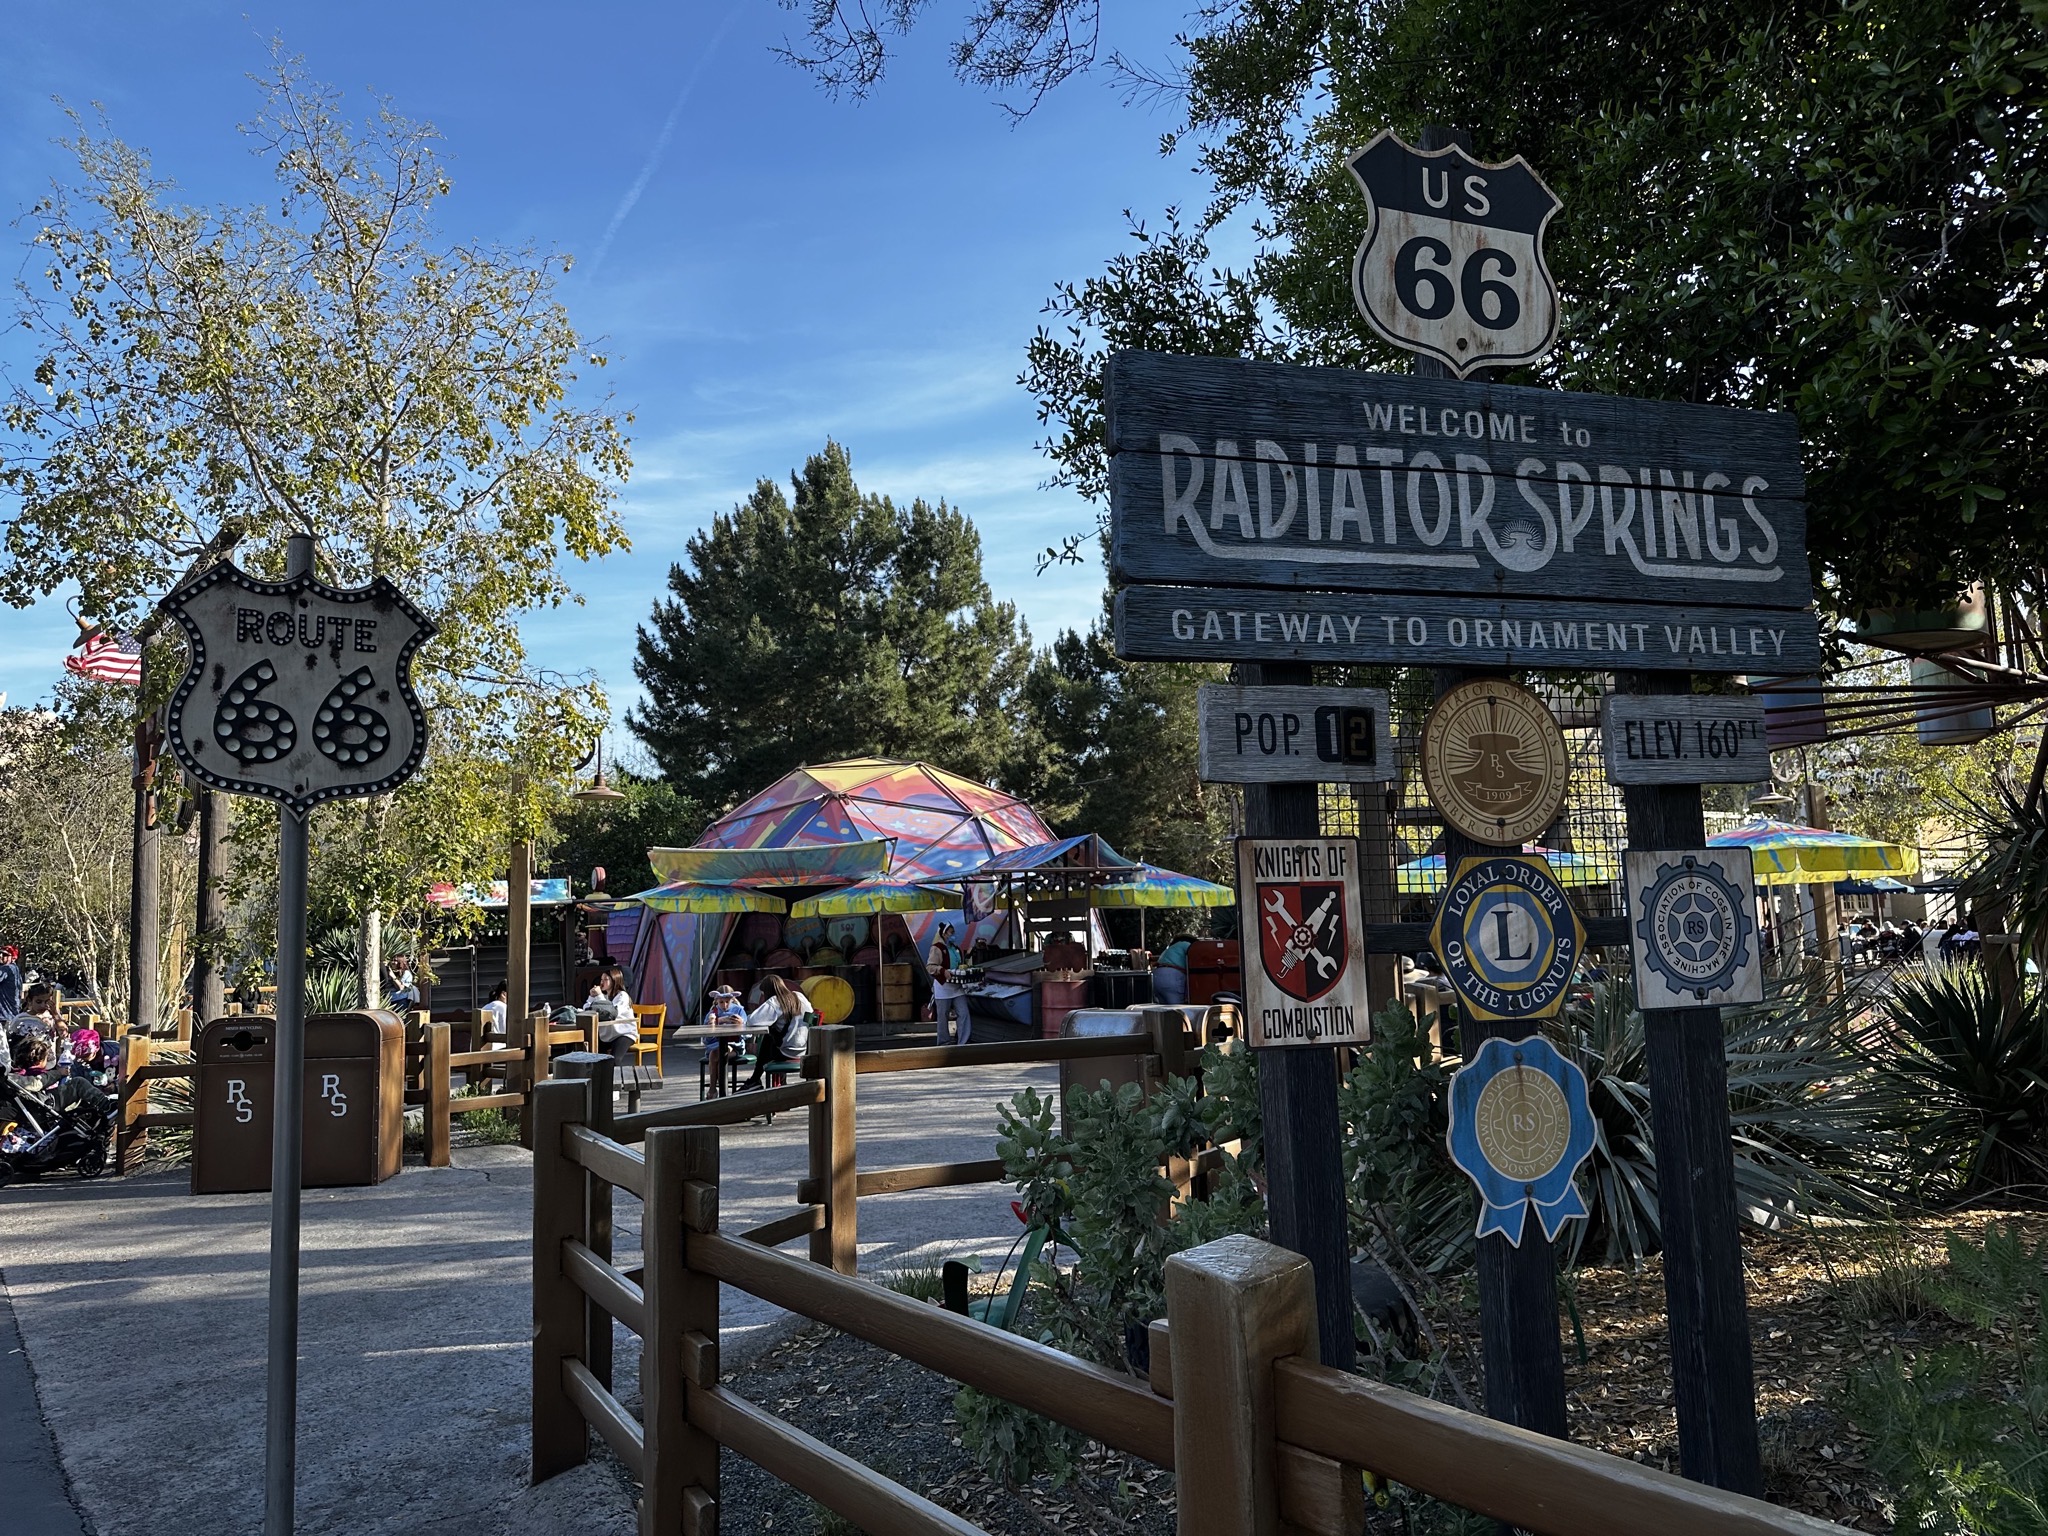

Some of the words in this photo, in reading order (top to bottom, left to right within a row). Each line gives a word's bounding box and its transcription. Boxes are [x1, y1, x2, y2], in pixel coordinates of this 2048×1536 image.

[1421, 167, 1491, 217] US
[1395, 236, 1521, 330] 66
[1363, 402, 1536, 444] WELCOME
[1560, 421, 1591, 448] to
[1159, 433, 1505, 568] RADIATOR
[1498, 458, 1785, 582] SPRINGS
[236, 607, 378, 653] ROUTE
[1171, 609, 1361, 645] GATEWAY
[1382, 616, 1427, 648] TO
[1448, 618, 1648, 653] ORNAMENT
[1665, 625, 1787, 657] VALLEY
[214, 659, 390, 763] 66
[1236, 712, 1300, 756] POP.
[1325, 711, 1370, 757] 12
[1429, 683, 1495, 745] RADIATOR
[1503, 685, 1560, 747] SPRINGS
[1625, 719, 1689, 761] ELEV.
[1490, 754, 1505, 779] RS
[1427, 755, 1477, 832] CHAMBER
[1484, 825, 1505, 839] OF
[1511, 758, 1564, 838] COMMERCE
[1485, 790, 1513, 802] 1909
[1254, 846, 1320, 877] KNIGHTS
[1328, 847, 1347, 877] OF
[1448, 865, 1500, 918] LOYAL
[1504, 863, 1563, 916] ORDER
[1688, 880, 1703, 890] OF
[1705, 885, 1729, 914] COGS
[1490, 910, 1532, 961] L
[1658, 882, 1686, 956] ASSOCIATION
[1686, 920, 1705, 936] RS
[1724, 917, 1733, 930] IN
[1673, 956, 1721, 974] MACHINE
[1719, 935, 1733, 959] THE
[1447, 939, 1467, 969] OF
[1462, 971, 1501, 1009] THE
[1507, 937, 1571, 1011] LUGNUTS
[1262, 1005, 1355, 1040] COMBUSTION
[227, 1079, 253, 1124] RS
[321, 1073, 348, 1118] RS
[1480, 1075, 1510, 1158] DOWNTOWN
[1514, 1070, 1564, 1113] RADIATOR
[1540, 1116, 1567, 1169] SPRINGS
[1512, 1112, 1536, 1132] RS
